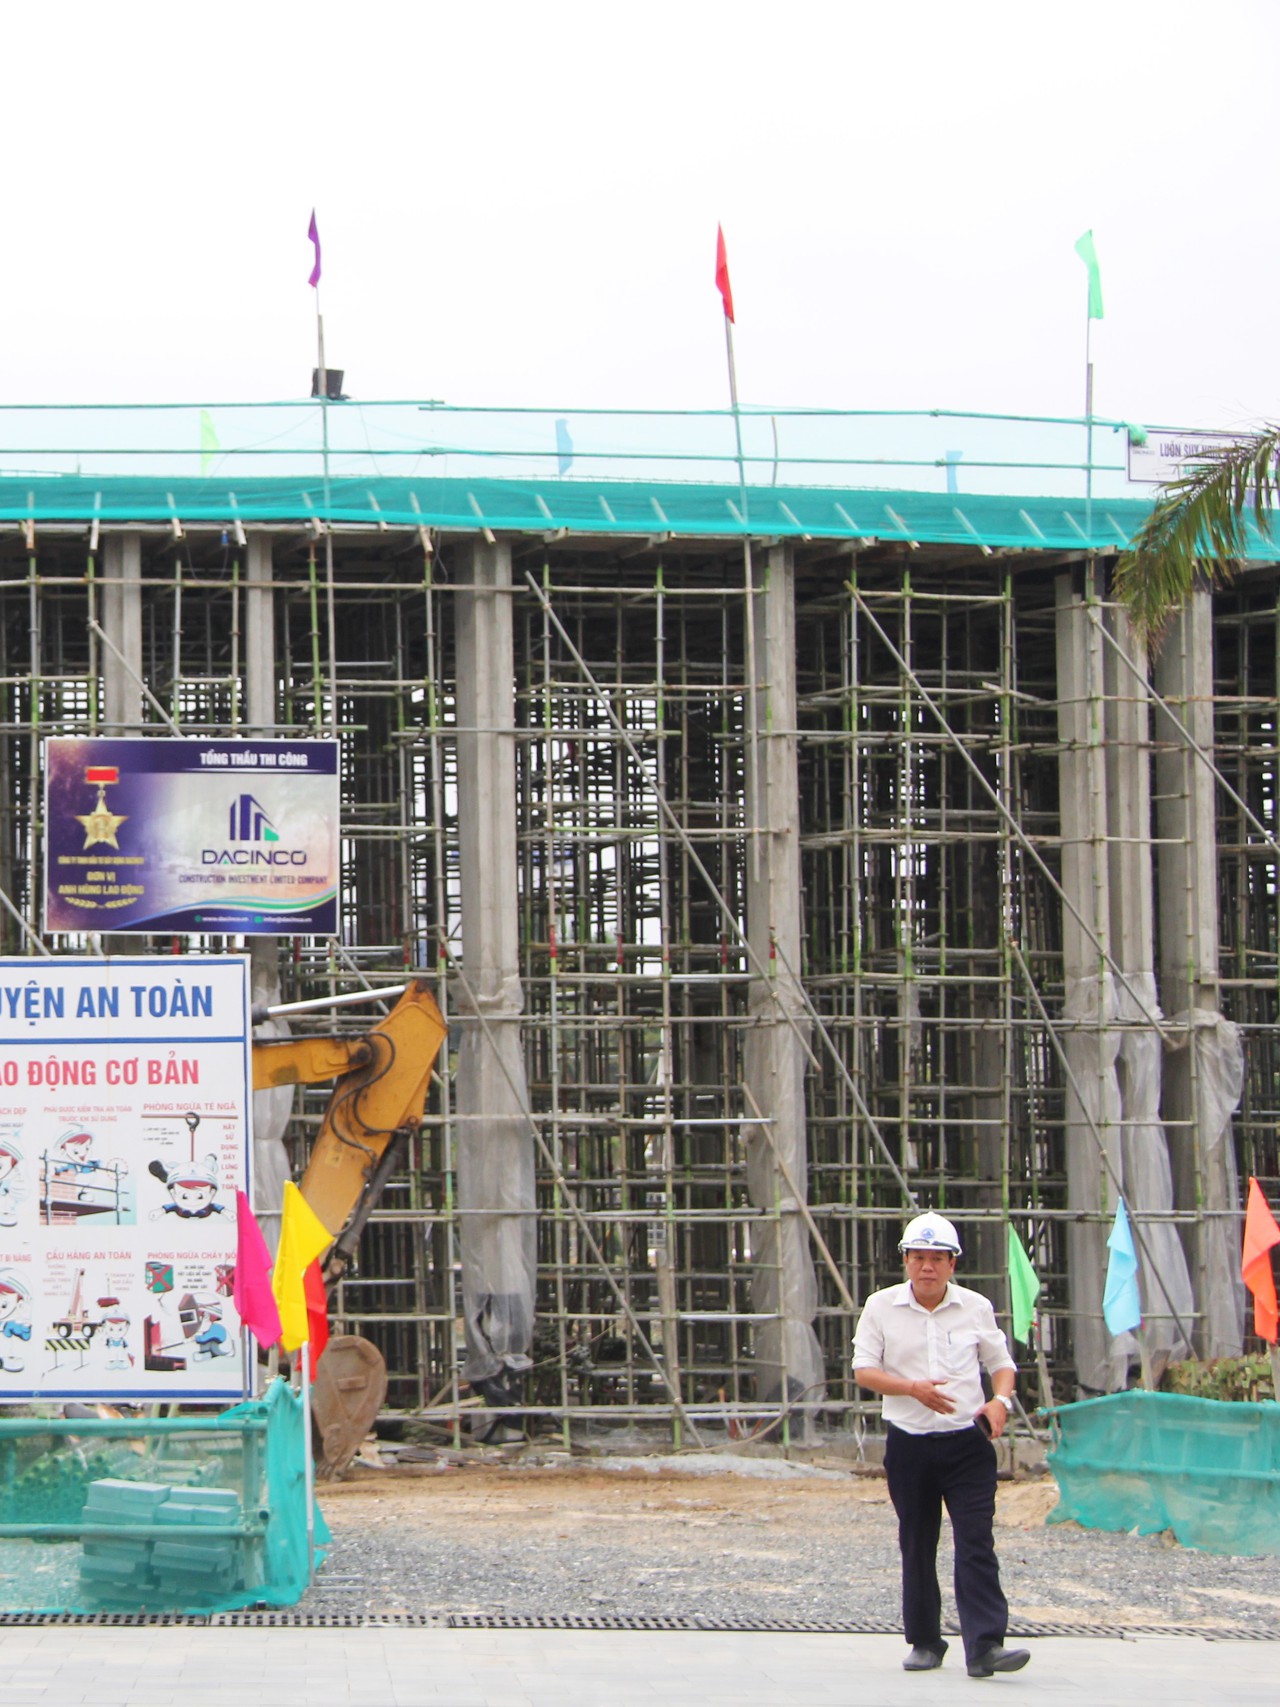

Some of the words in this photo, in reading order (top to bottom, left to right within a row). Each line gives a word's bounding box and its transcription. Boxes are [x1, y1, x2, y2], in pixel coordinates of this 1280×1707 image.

[260, 754, 277, 766] THI
[278, 751, 308, 766] CÔNG
[201, 849, 307, 866] DACINCO
[75, 986, 120, 1018] AN
[130, 978, 214, 1018] TOÀN
[27, 1055, 97, 1092] ĐỘNG
[105, 1056, 140, 1086] CƠ
[147, 1050, 200, 1085] BẢN
